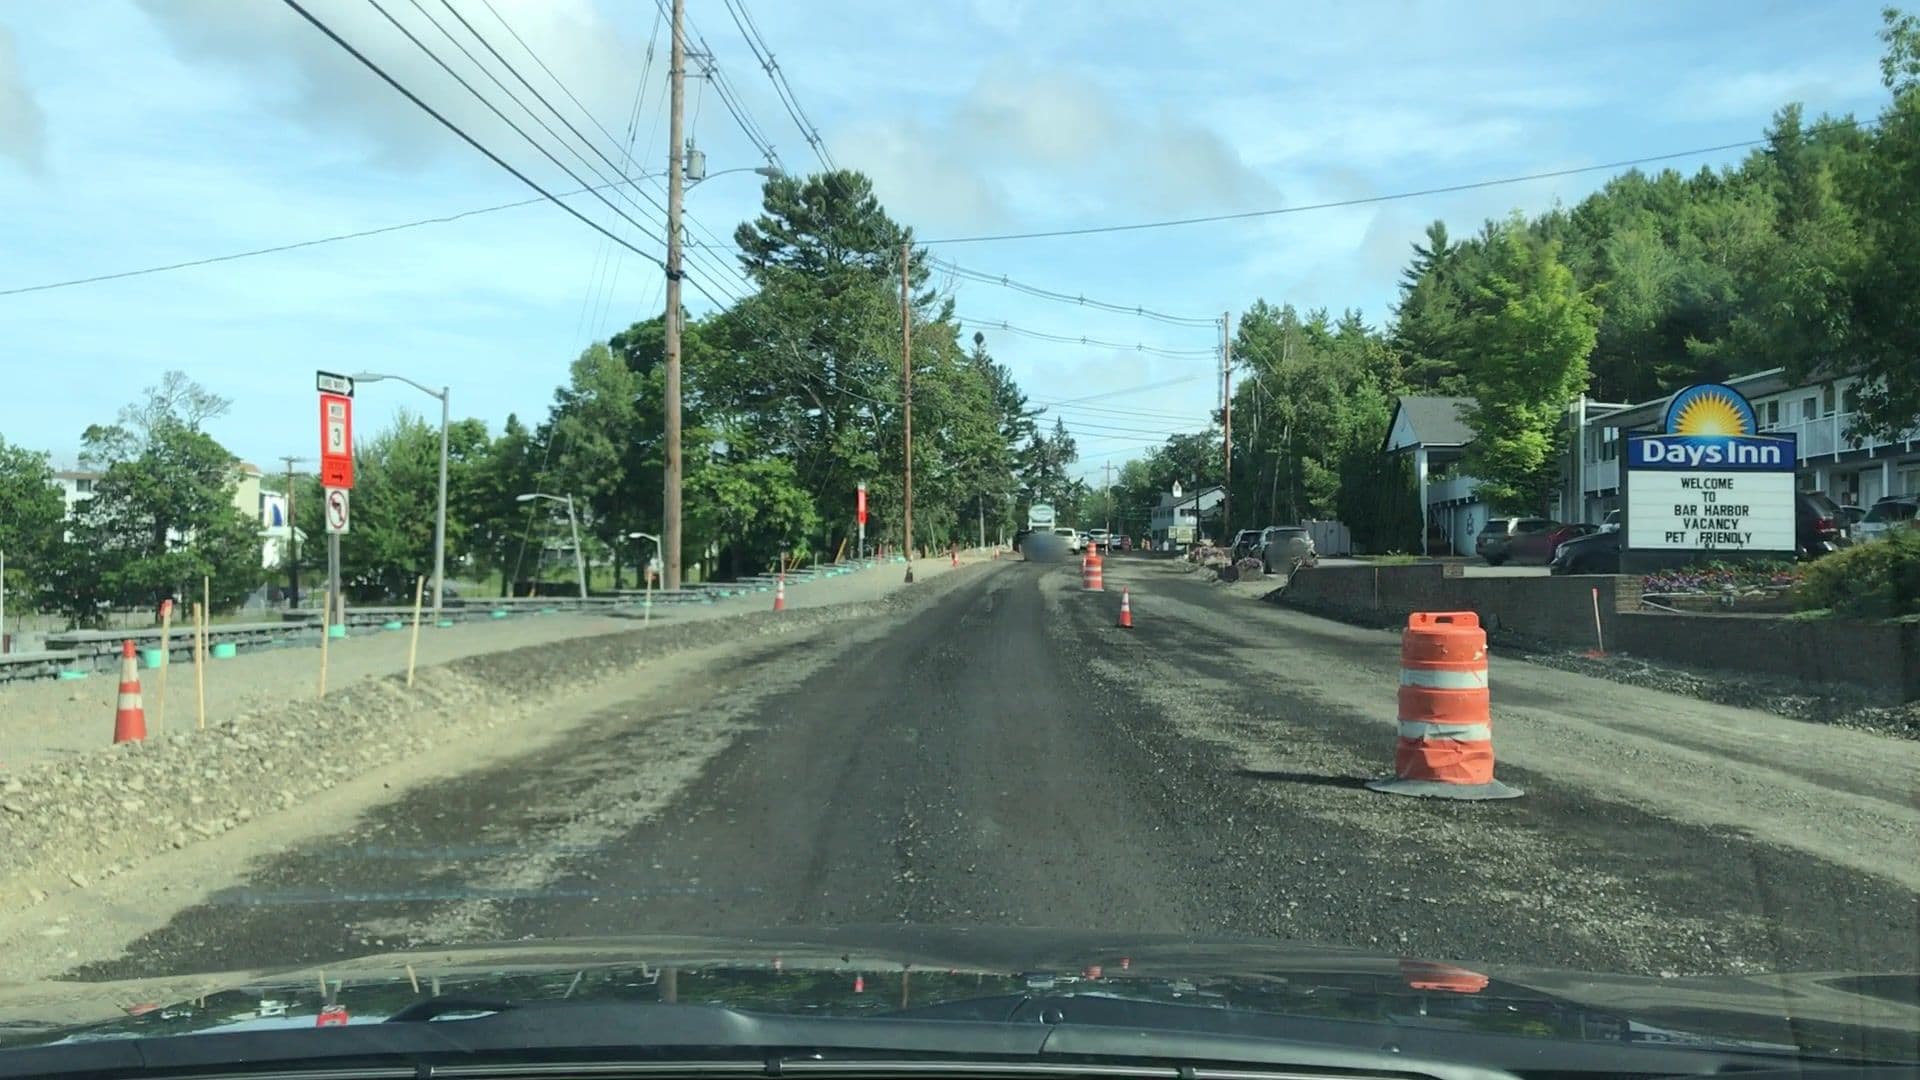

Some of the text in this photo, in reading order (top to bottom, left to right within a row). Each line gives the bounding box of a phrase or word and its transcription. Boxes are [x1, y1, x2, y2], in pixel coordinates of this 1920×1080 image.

[1643, 439, 1781, 466] Days Inn
[1680, 477, 1734, 490] WELCOME
[1701, 491, 1717, 503] TO
[1674, 504, 1749, 517] BAR HARBOR
[1683, 518, 1740, 530] VACANCY
[1665, 531, 1753, 544] PET FRIENDLY
